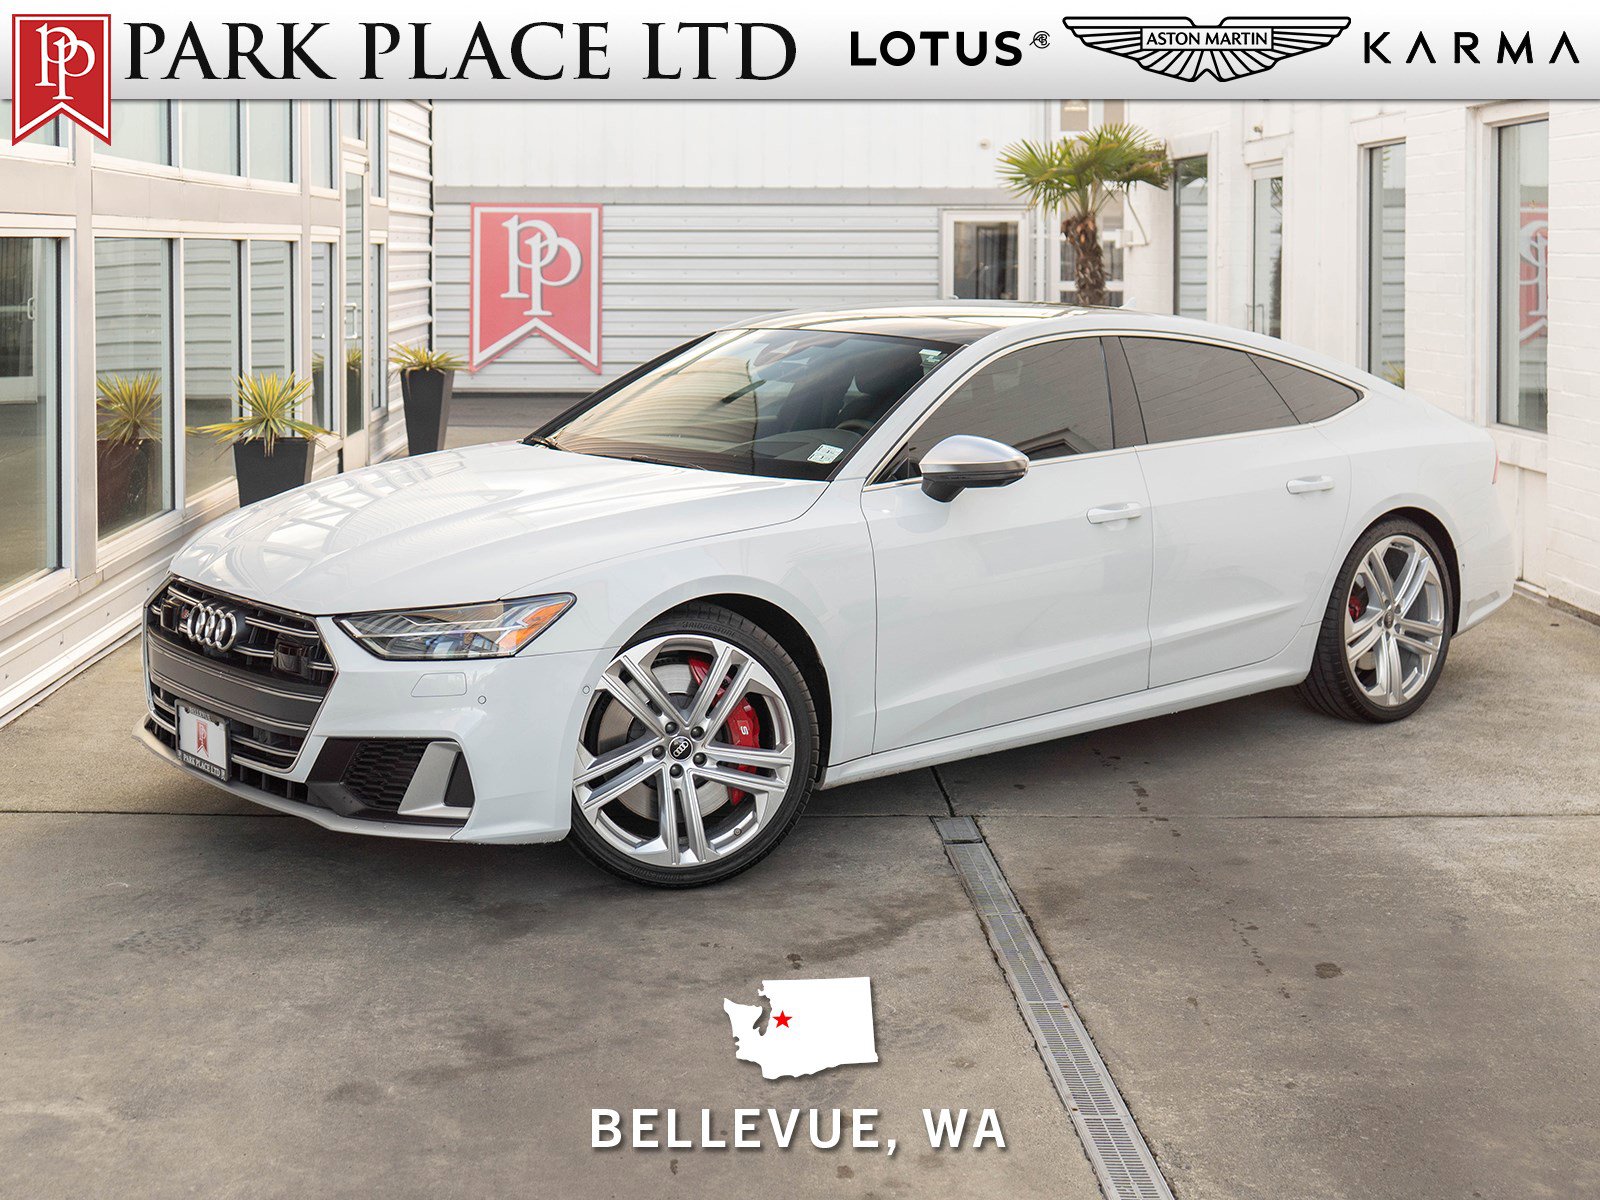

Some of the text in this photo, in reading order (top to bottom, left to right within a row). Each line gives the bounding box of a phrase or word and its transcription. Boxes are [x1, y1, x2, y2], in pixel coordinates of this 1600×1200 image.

[183, 753, 221, 777] PARK PLACE LTD
